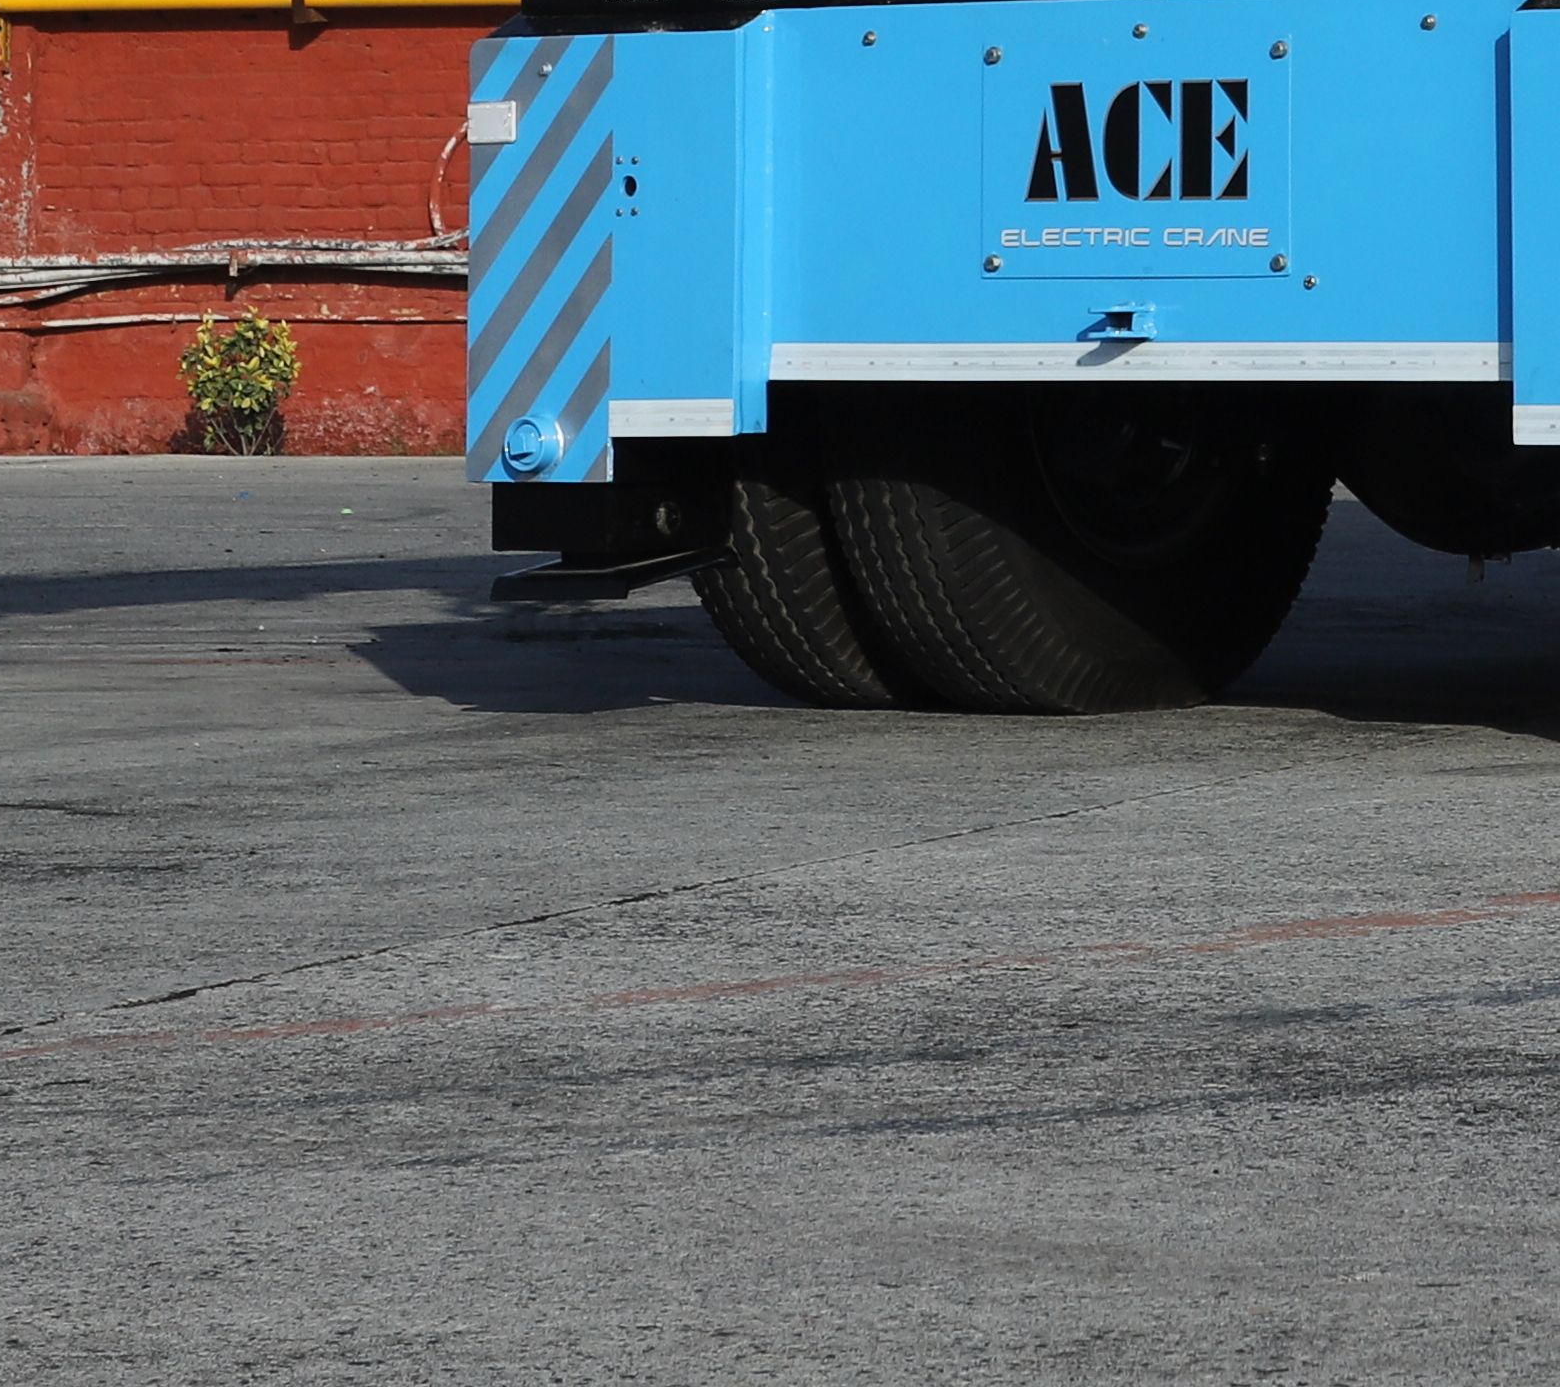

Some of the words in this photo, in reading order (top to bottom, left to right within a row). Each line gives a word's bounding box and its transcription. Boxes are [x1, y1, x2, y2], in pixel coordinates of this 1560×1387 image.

[1024, 78, 1249, 203] ACE
[1001, 227, 1151, 248] ELECTRIC
[1163, 227, 1271, 248] CRANE
